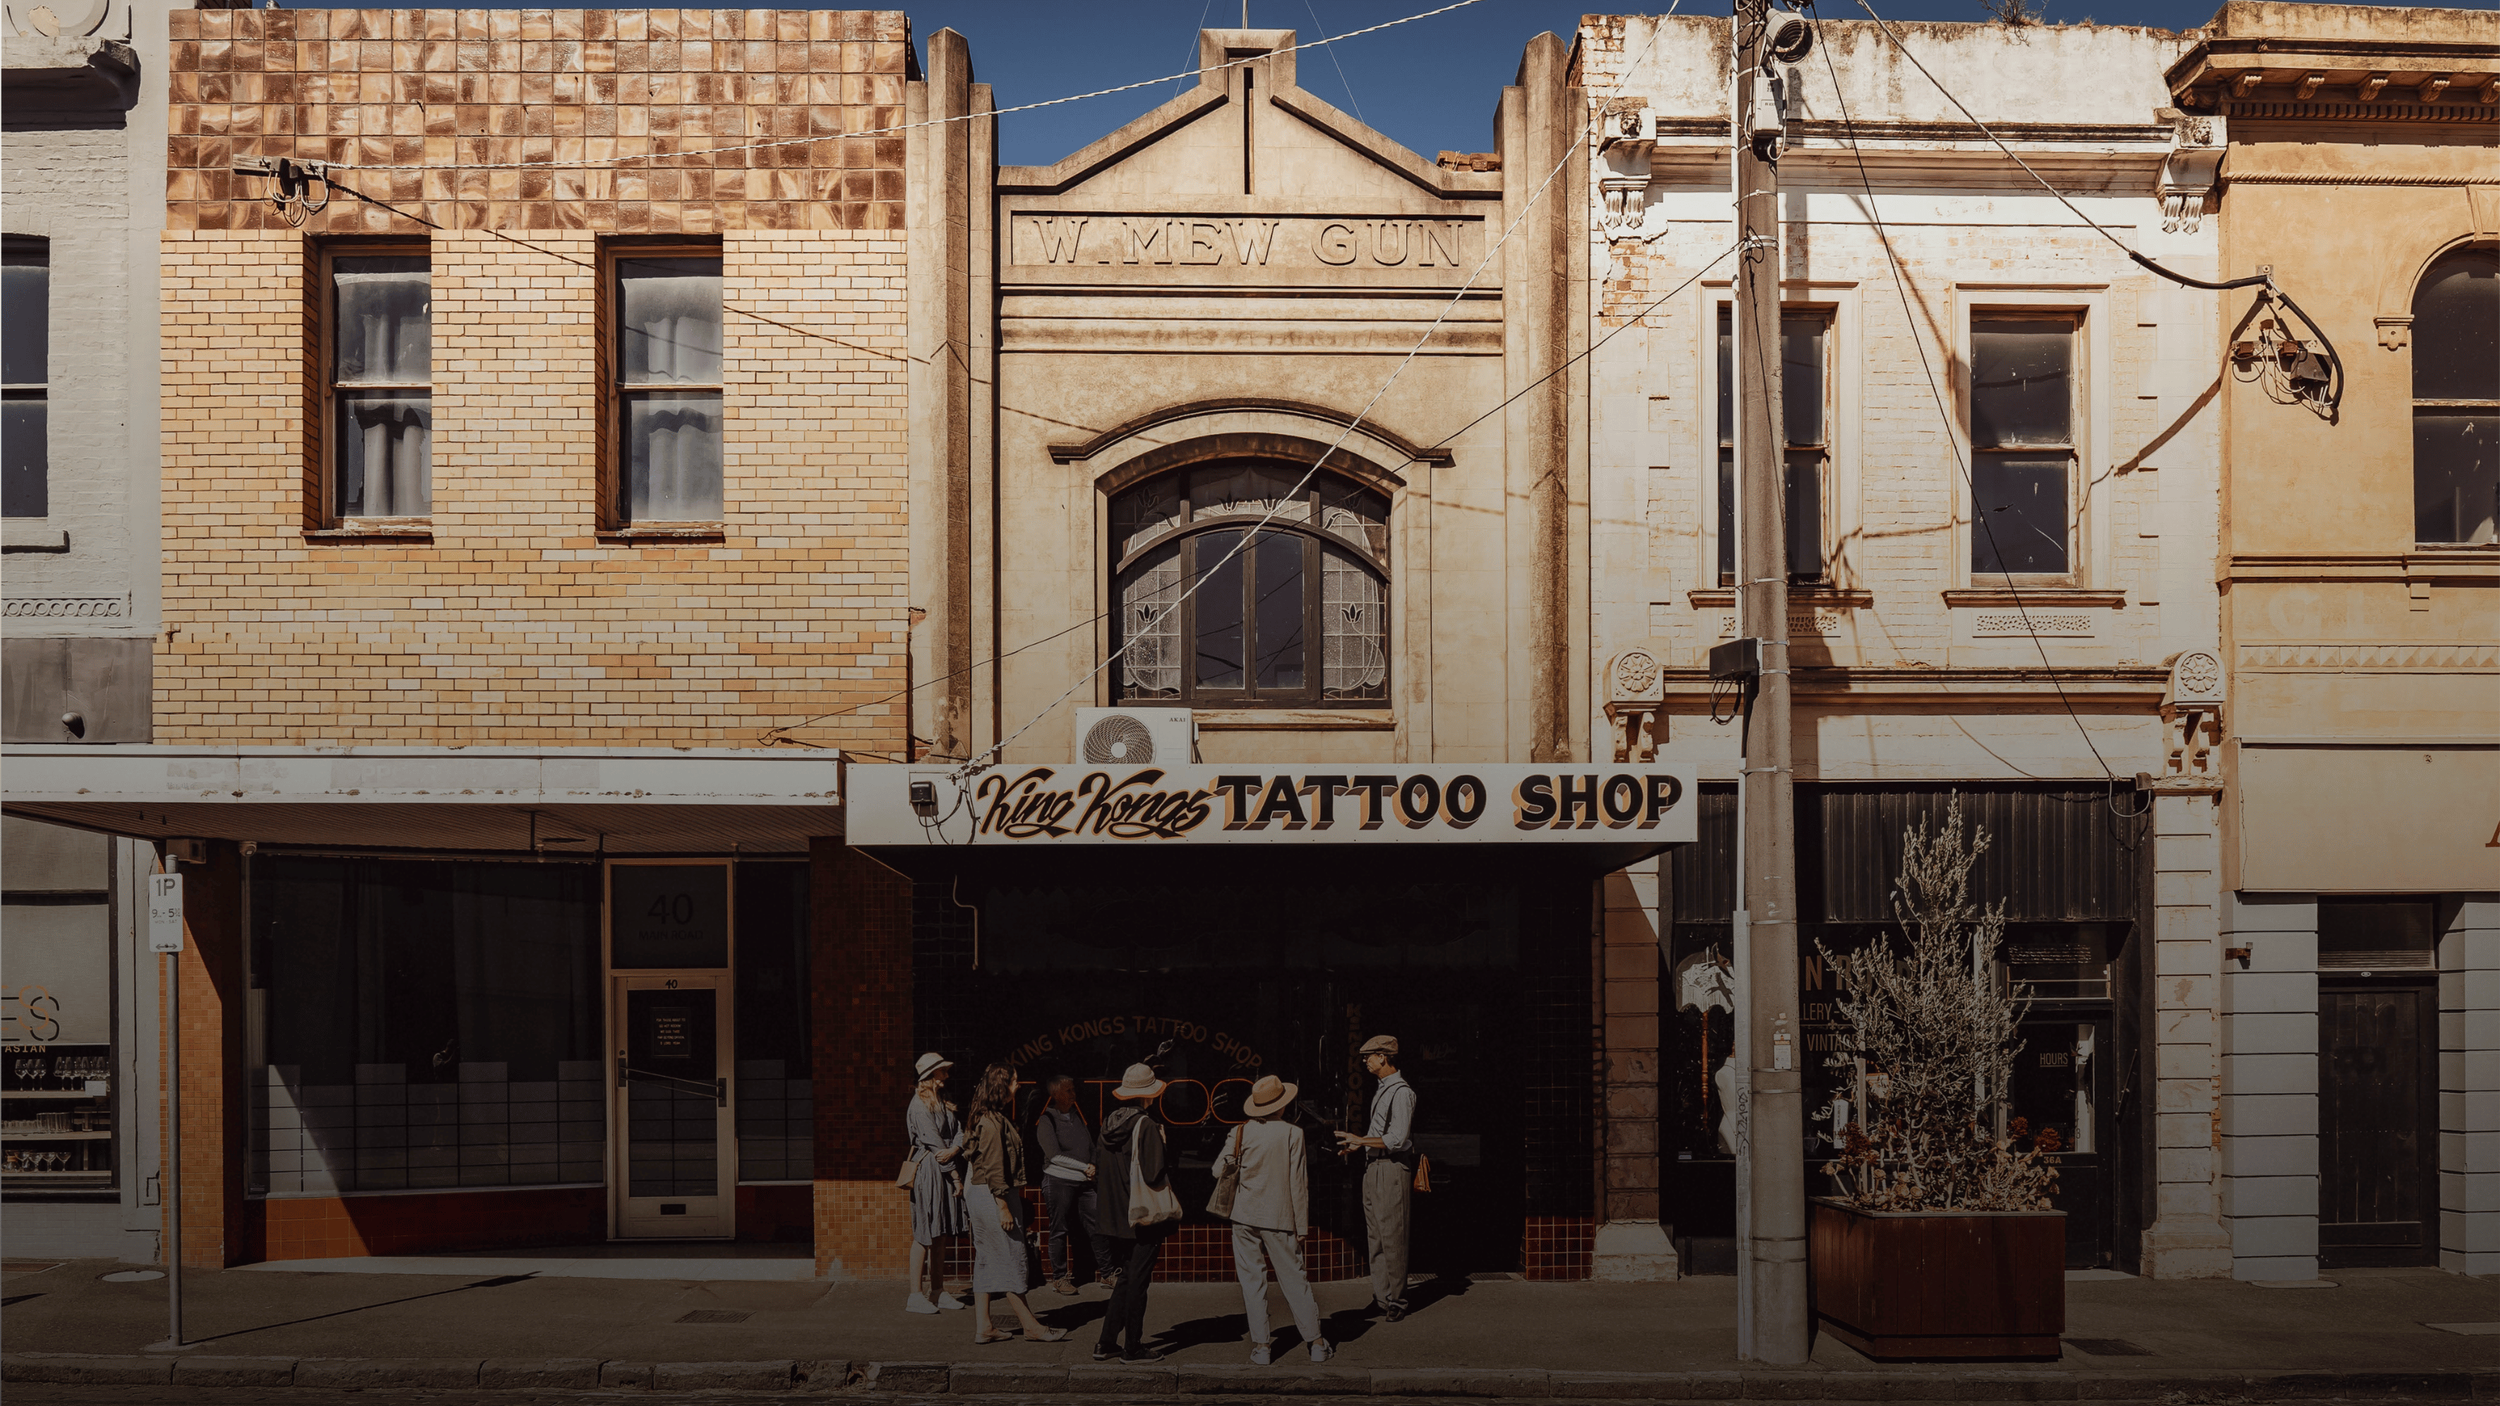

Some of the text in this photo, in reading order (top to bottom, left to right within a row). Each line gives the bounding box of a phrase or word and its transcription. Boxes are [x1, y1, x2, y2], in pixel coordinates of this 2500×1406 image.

[1121, 216, 1281, 266] MEW
[1311, 218, 1464, 268] GUN
[975, 768, 1683, 840] King Kongs TATTOO SHOP
[156, 878, 176, 897] 1P
[647, 893, 694, 925] 40
[638, 930, 704, 941] MAIN ROAD
[665, 979, 678, 989] 40
[4, 1045, 47, 1054] ASIAN
[1005, 1015, 1263, 1068] KING KONGS TATTOO SHOP
[2039, 1052, 2069, 1066] HOURS
[2043, 1156, 2062, 1165] 36A
